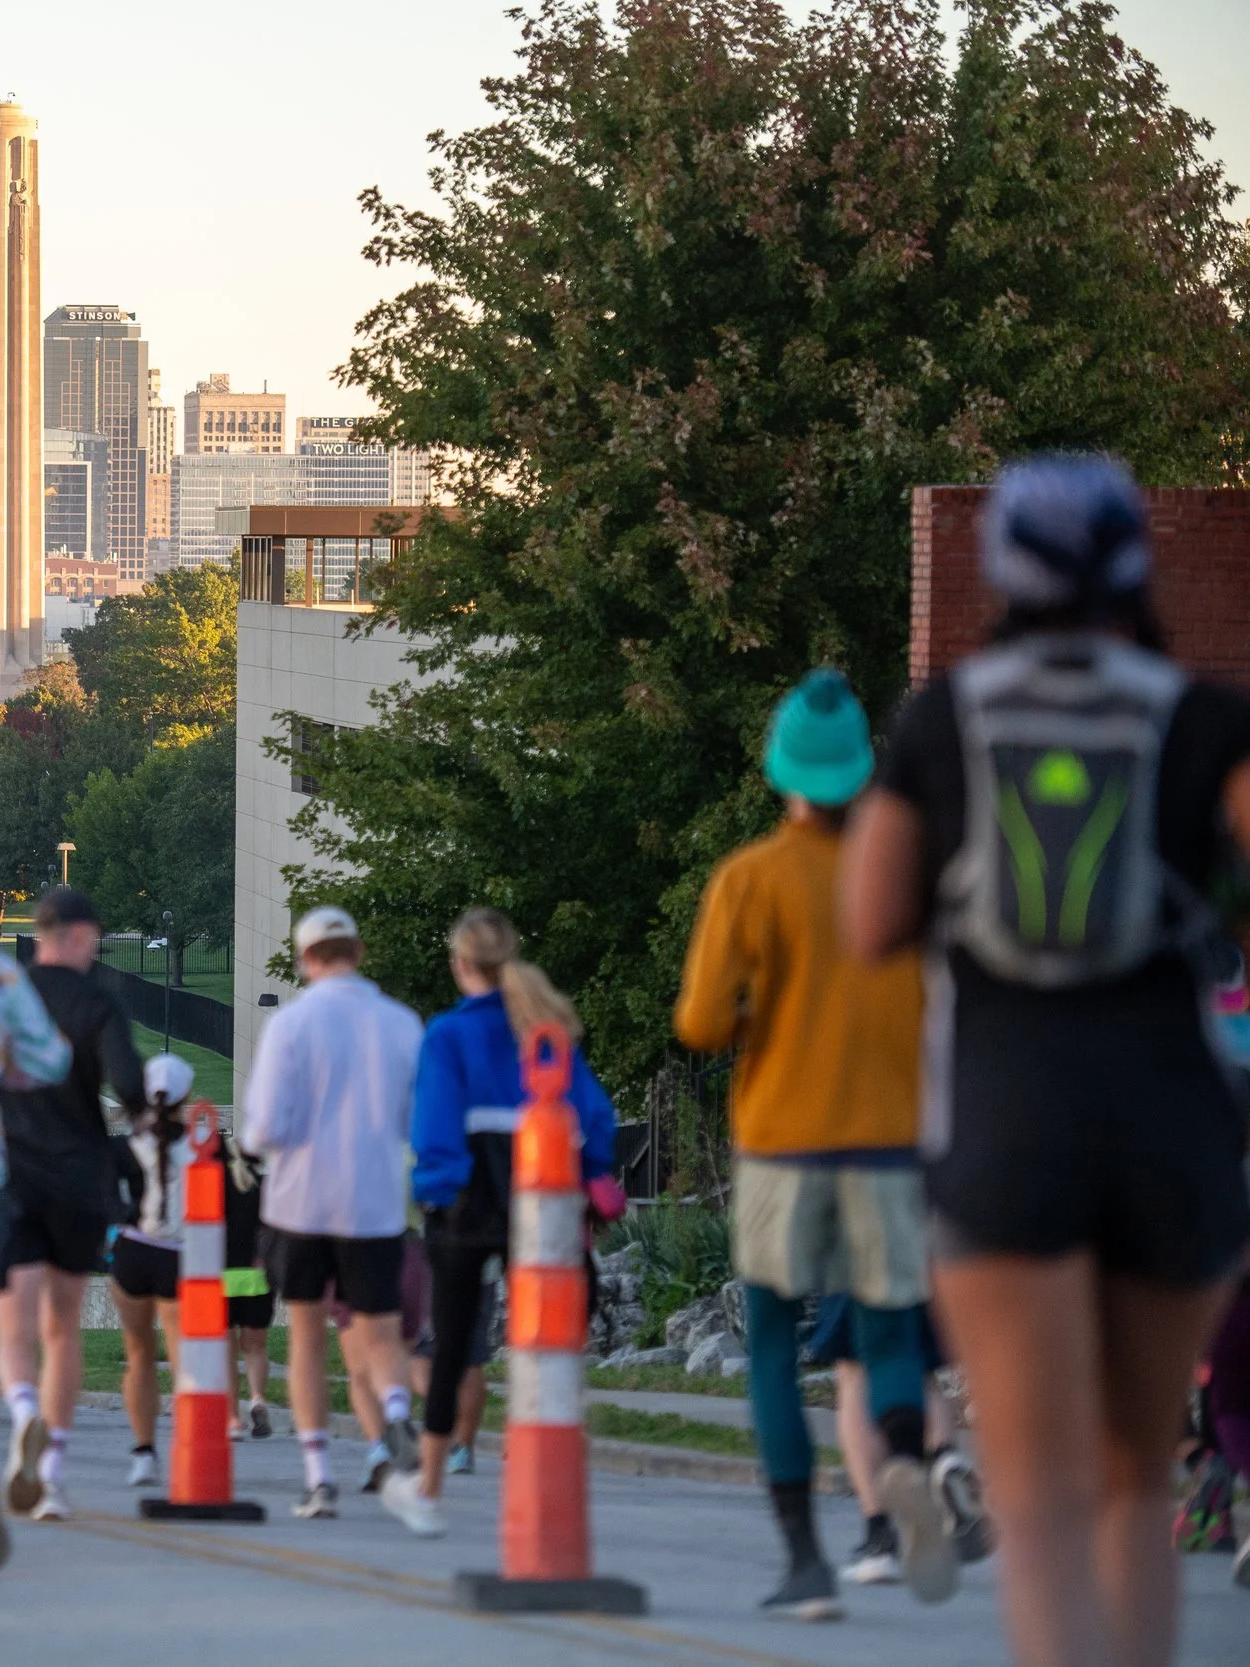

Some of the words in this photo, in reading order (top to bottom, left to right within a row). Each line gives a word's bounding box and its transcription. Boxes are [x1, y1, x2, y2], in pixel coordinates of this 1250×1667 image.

[69, 311, 121, 320] STINSON
[311, 418, 340, 427] THE
[313, 443, 344, 455] TWO
[348, 443, 386, 455] LIGHT
